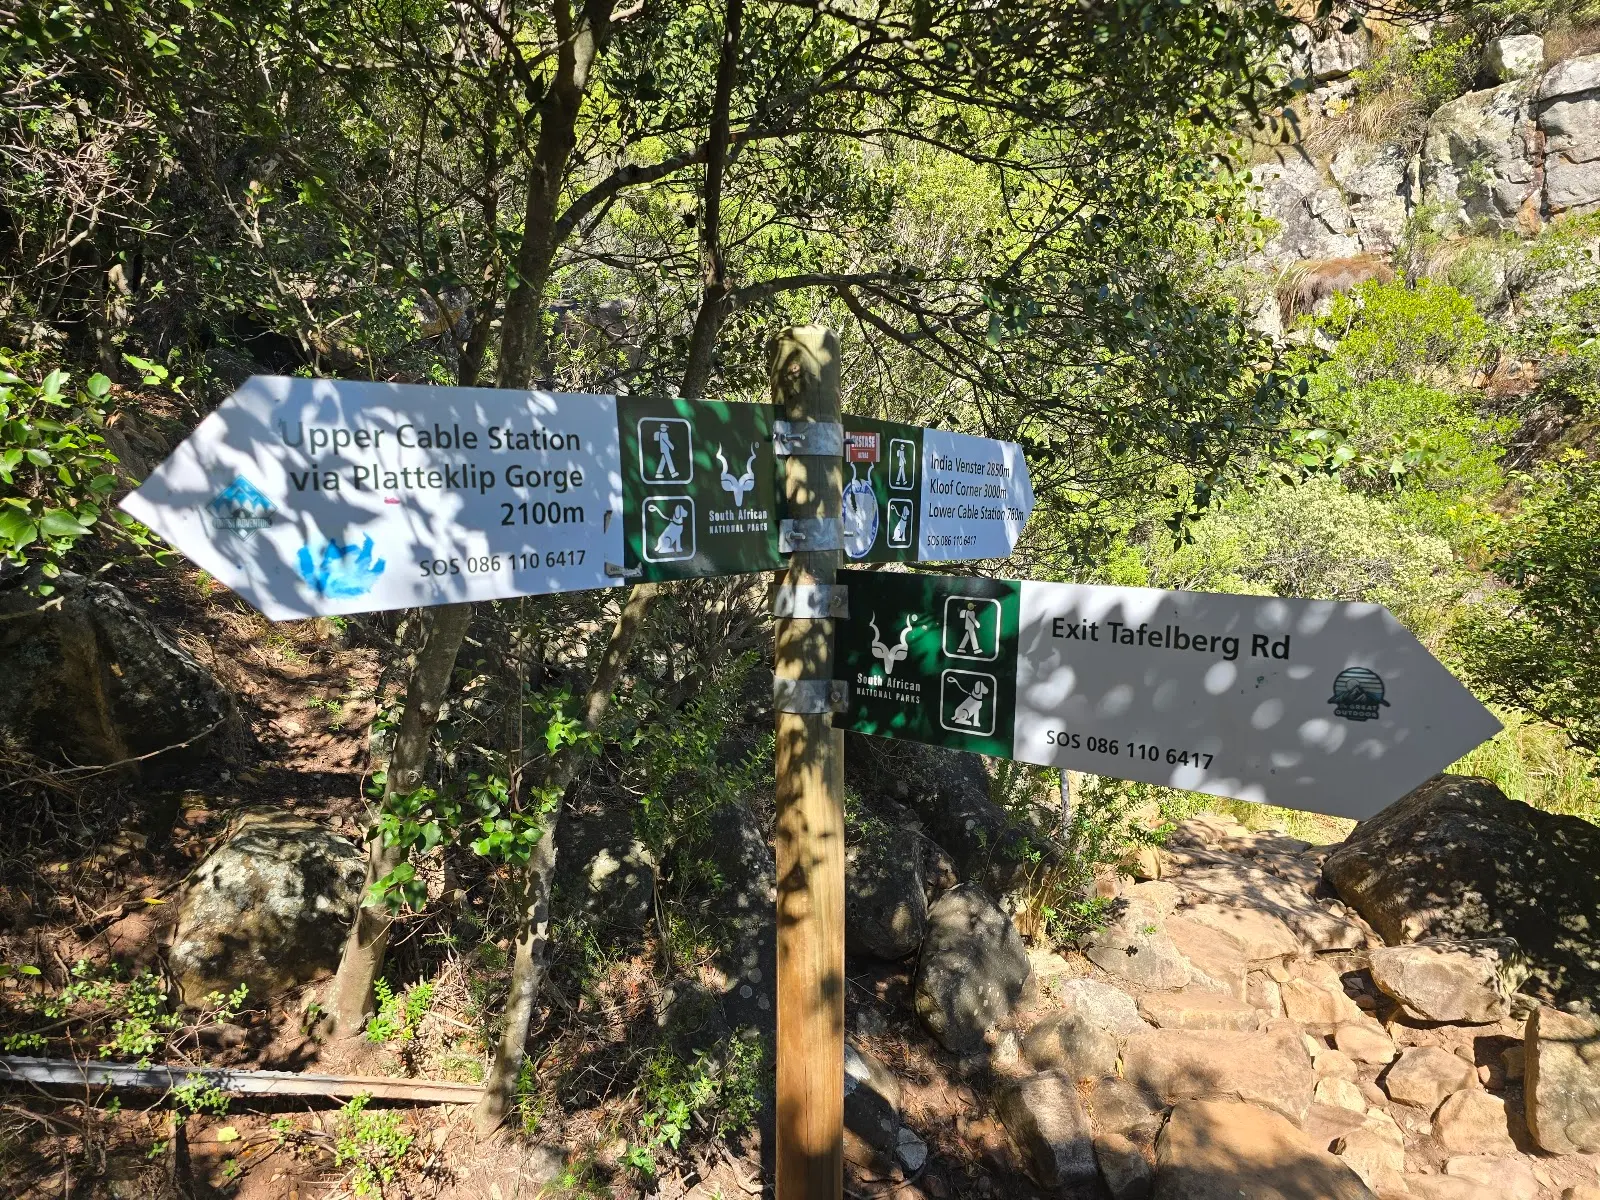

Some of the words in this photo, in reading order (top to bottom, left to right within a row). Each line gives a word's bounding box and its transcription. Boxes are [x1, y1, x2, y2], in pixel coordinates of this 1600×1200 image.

[279, 418, 384, 455] Upper
[396, 424, 478, 449] Cable
[488, 426, 581, 450] Station
[931, 454, 953, 471] India
[956, 457, 985, 475] Venster
[986, 462, 1010, 478] 2850m
[290, 464, 340, 491] via
[353, 463, 496, 495] Platteklip
[505, 465, 583, 493] Gorge
[930, 478, 954, 494] Kloof
[956, 481, 982, 497] Corner
[984, 484, 1007, 499] 3000m
[501, 502, 584, 526] 2100m
[709, 510, 734, 521] South
[738, 508, 768, 520] African
[929, 503, 955, 518] Lower
[957, 504, 979, 519] Cable
[981, 506, 1006, 520] Station
[1006, 508, 1024, 520] 760m
[709, 524, 744, 534] NATIONAL
[747, 522, 768, 532] PARKS
[927, 535, 940, 546] SOS
[941, 535, 952, 546] 086
[953, 535, 963, 546] 110
[963, 535, 977, 546] 6417
[420, 558, 460, 577] SOS
[467, 556, 501, 573] 086
[508, 553, 540, 570] 110
[546, 550, 586, 568] 6417
[1052, 618, 1099, 641] Exit
[1107, 621, 1240, 660] Tafelberg
[1251, 634, 1290, 660] Rd
[857, 672, 883, 686] South
[887, 677, 921, 692] African
[857, 687, 892, 700] NATIONAL
[896, 693, 921, 704] PARKS
[1046, 730, 1081, 749] SOS
[1087, 736, 1119, 755] 086
[1126, 743, 1160, 762] 110
[1166, 749, 1214, 770] 6417
